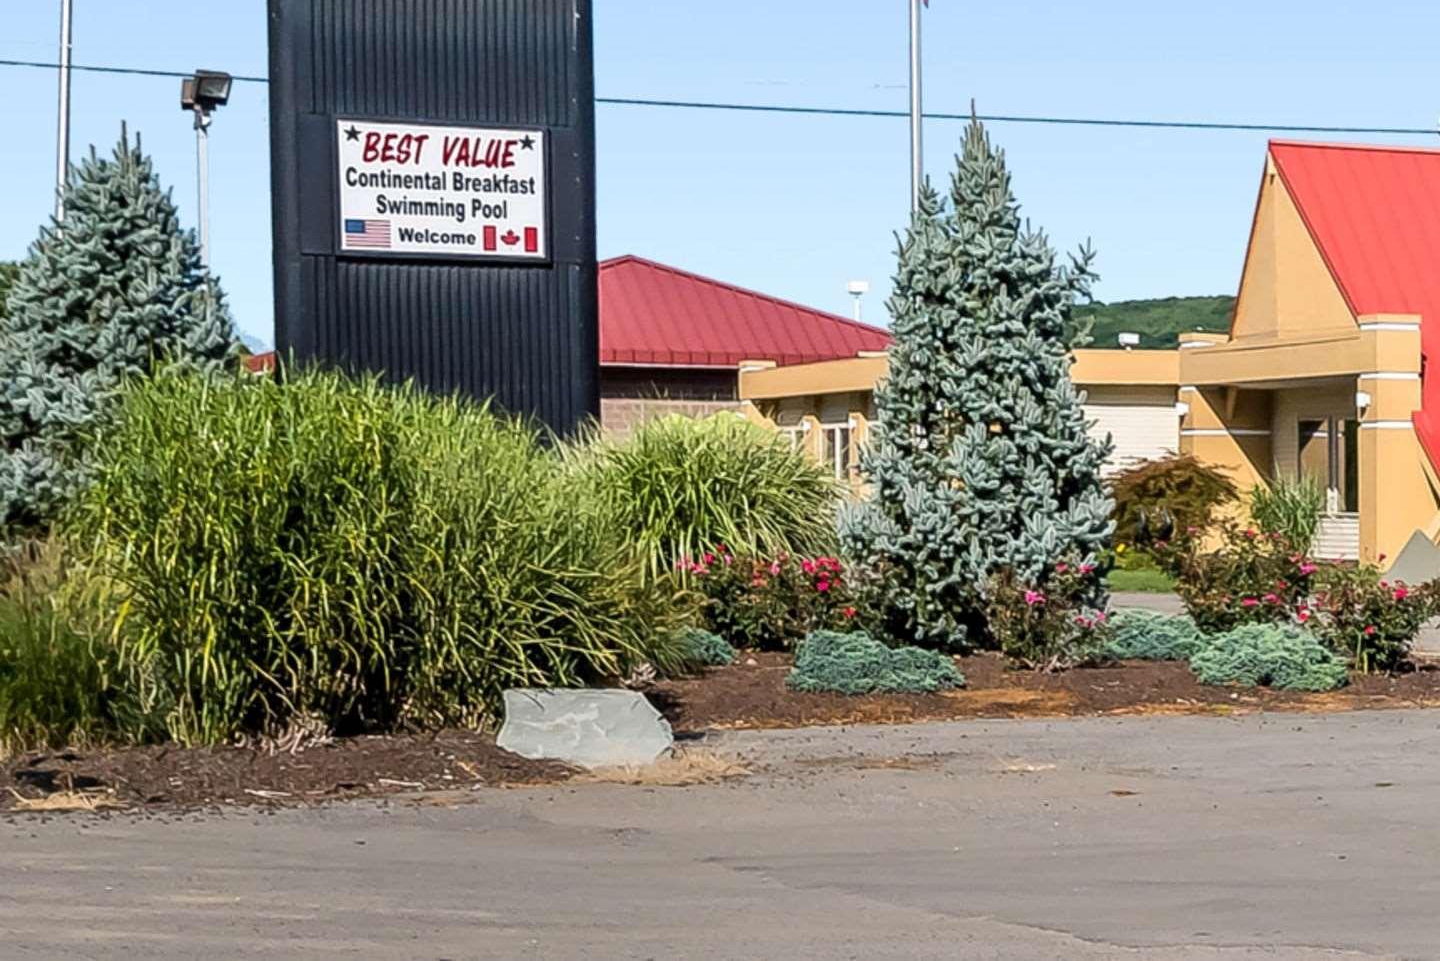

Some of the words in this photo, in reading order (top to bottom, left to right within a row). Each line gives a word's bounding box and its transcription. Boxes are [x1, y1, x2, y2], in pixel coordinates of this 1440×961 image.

[362, 131, 428, 166] BEST
[442, 136, 518, 168] VALUE
[345, 167, 447, 191] Continental
[452, 173, 536, 194] Breakfast
[376, 194, 466, 223] Swimming
[471, 199, 508, 219] Pool
[398, 227, 476, 245] Welcome
